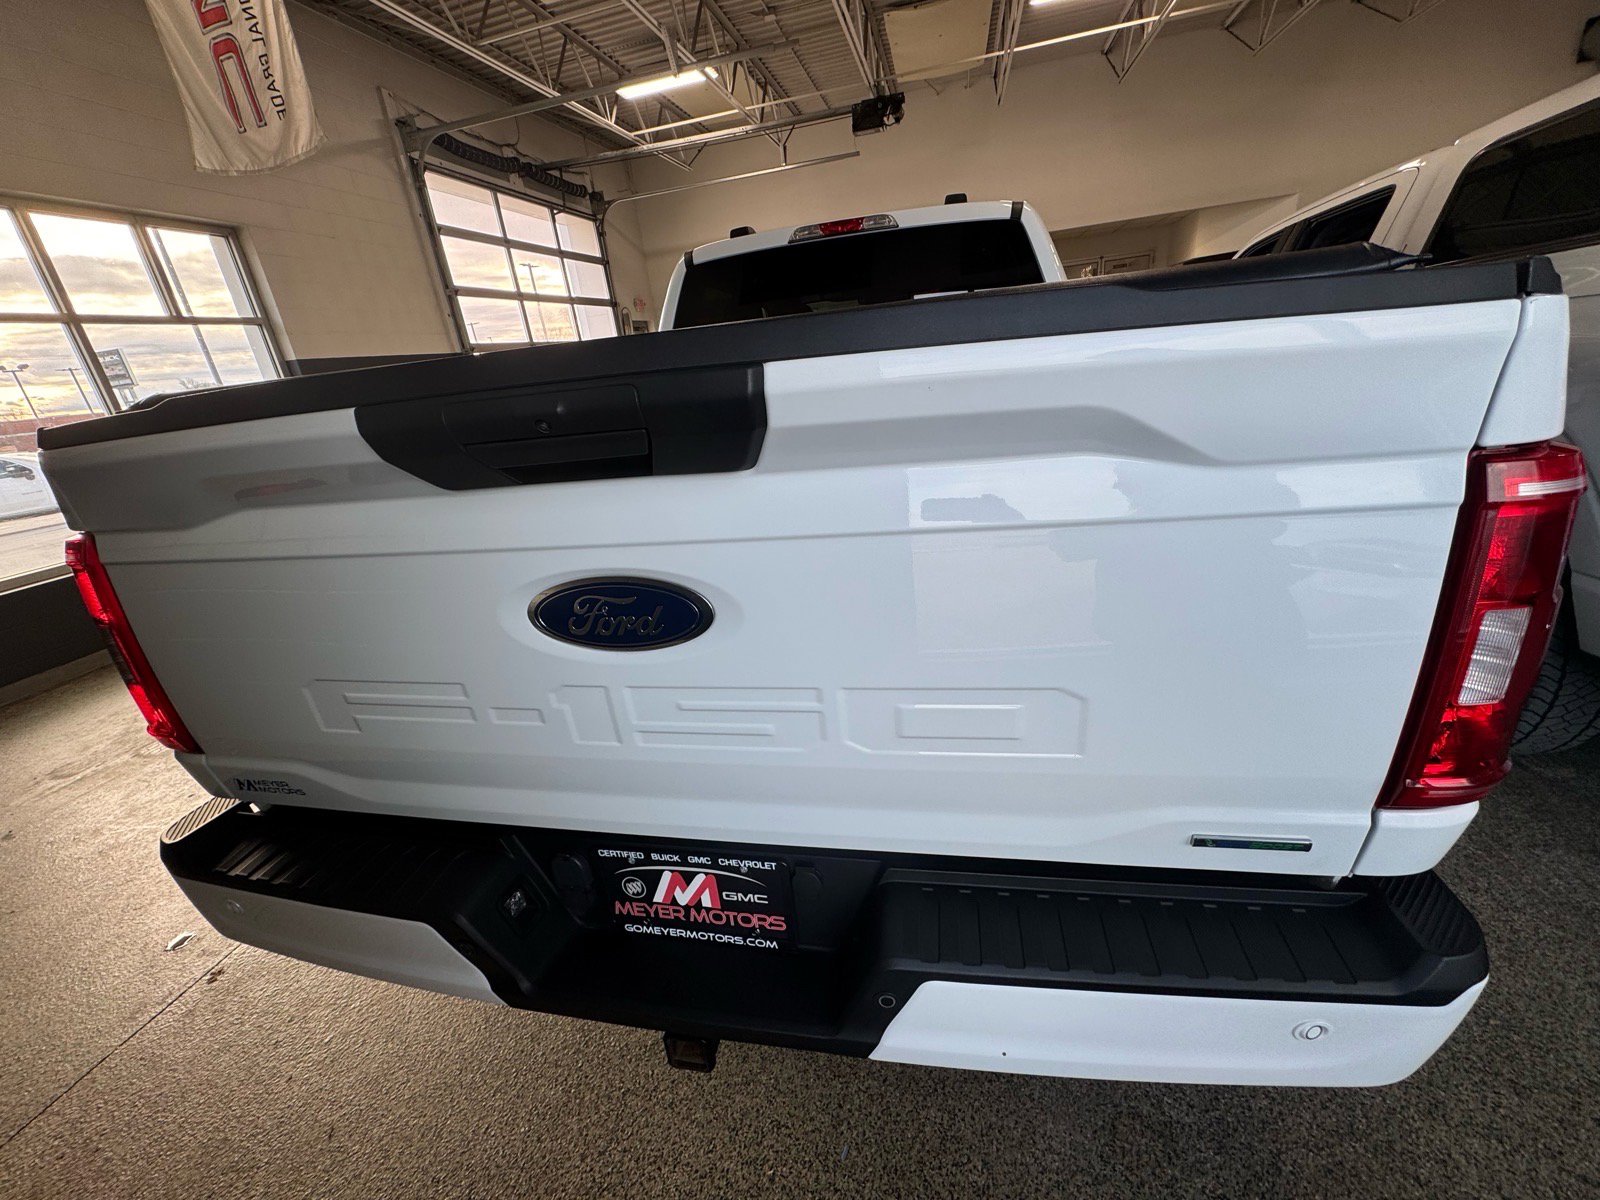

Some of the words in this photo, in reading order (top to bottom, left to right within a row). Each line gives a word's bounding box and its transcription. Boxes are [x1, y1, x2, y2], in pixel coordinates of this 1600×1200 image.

[568, 595, 664, 636] Ford
[302, 677, 1090, 760] F-150
[598, 849, 645, 860] CERTIFIED
[651, 853, 681, 862] BUICK
[687, 855, 712, 865] GMC
[718, 858, 777, 871] CHEVROLET
[722, 891, 769, 904] GMC
[614, 900, 686, 921] MEYER
[690, 907, 787, 931] MOTORS
[624, 923, 779, 949] GOMEYERMOTORS.COM
